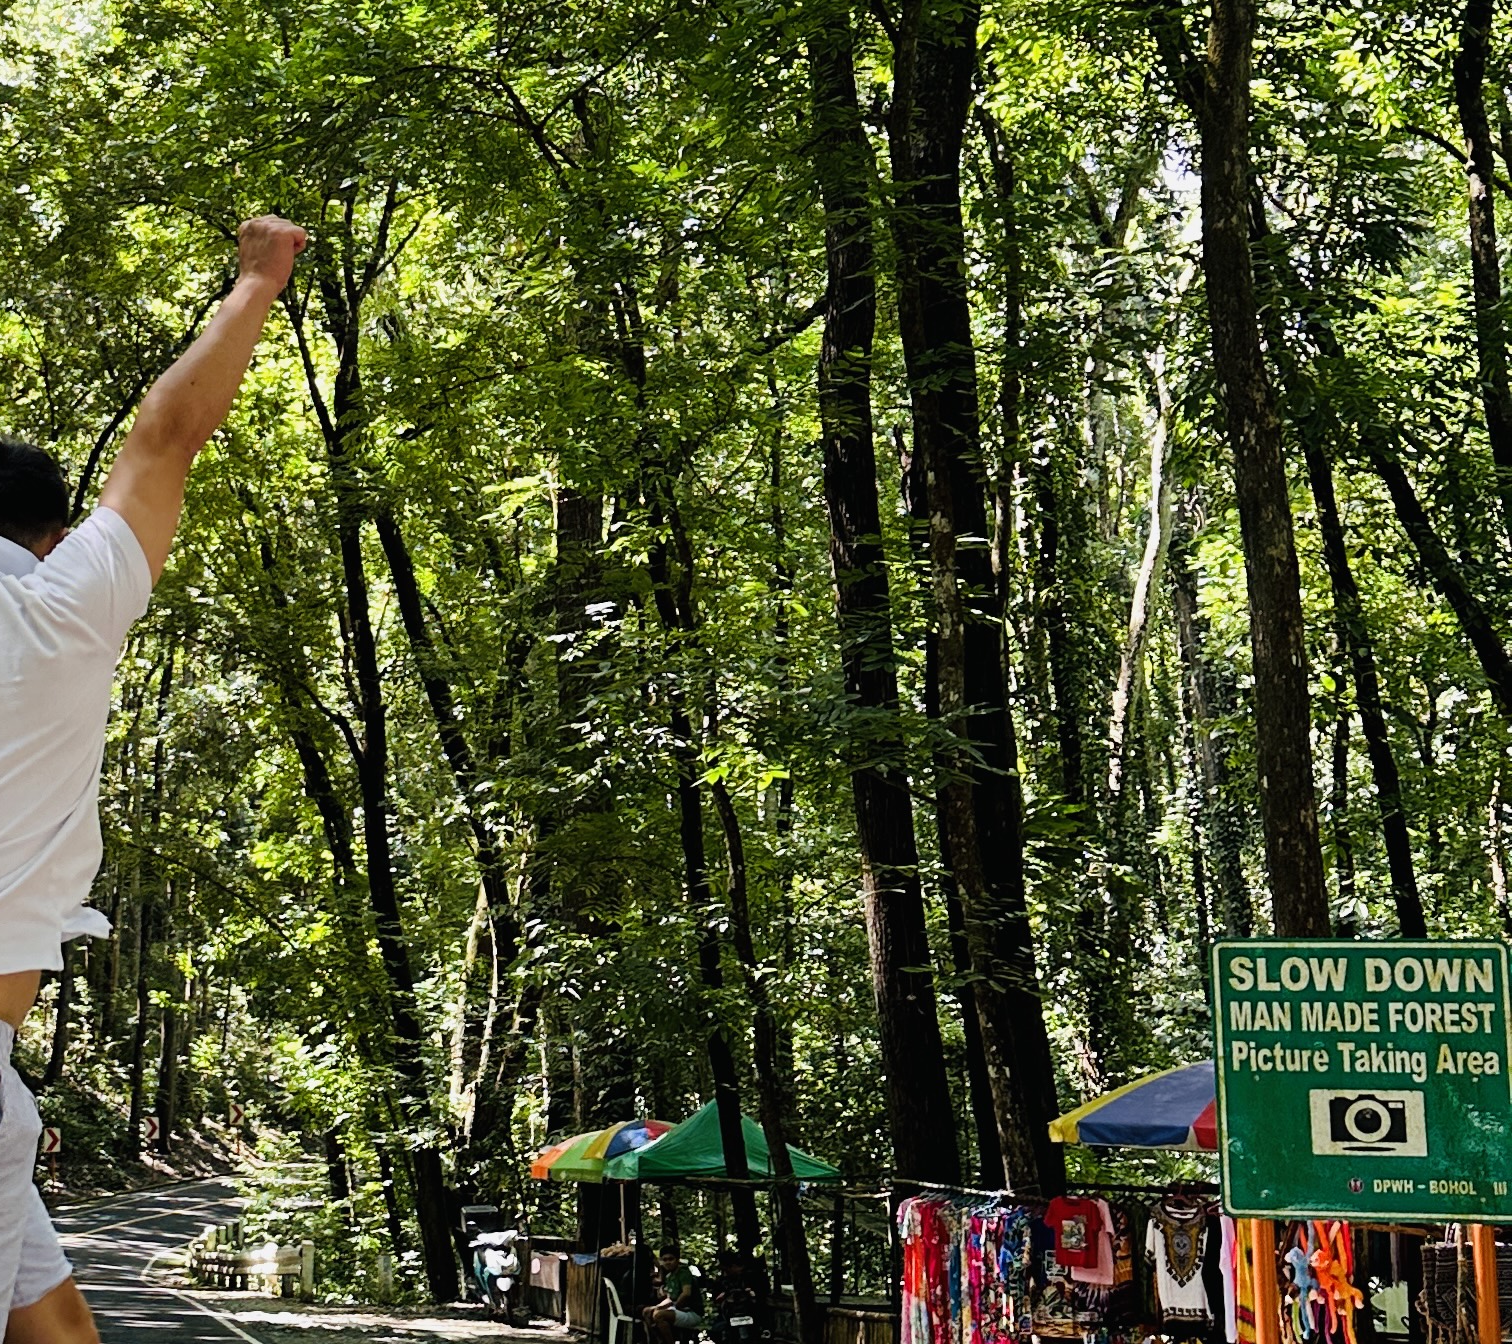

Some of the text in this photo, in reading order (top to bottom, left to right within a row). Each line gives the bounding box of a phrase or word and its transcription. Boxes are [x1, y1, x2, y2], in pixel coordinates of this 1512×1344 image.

[1228, 956, 1494, 993] SLOW DOWN
[1230, 1001, 1496, 1034] MAN MADE FOREST
[1231, 1040, 1500, 1083] Picture Taking Area
[1373, 1179, 1414, 1194] DPWH
[1429, 1180, 1477, 1195] BOHOL
